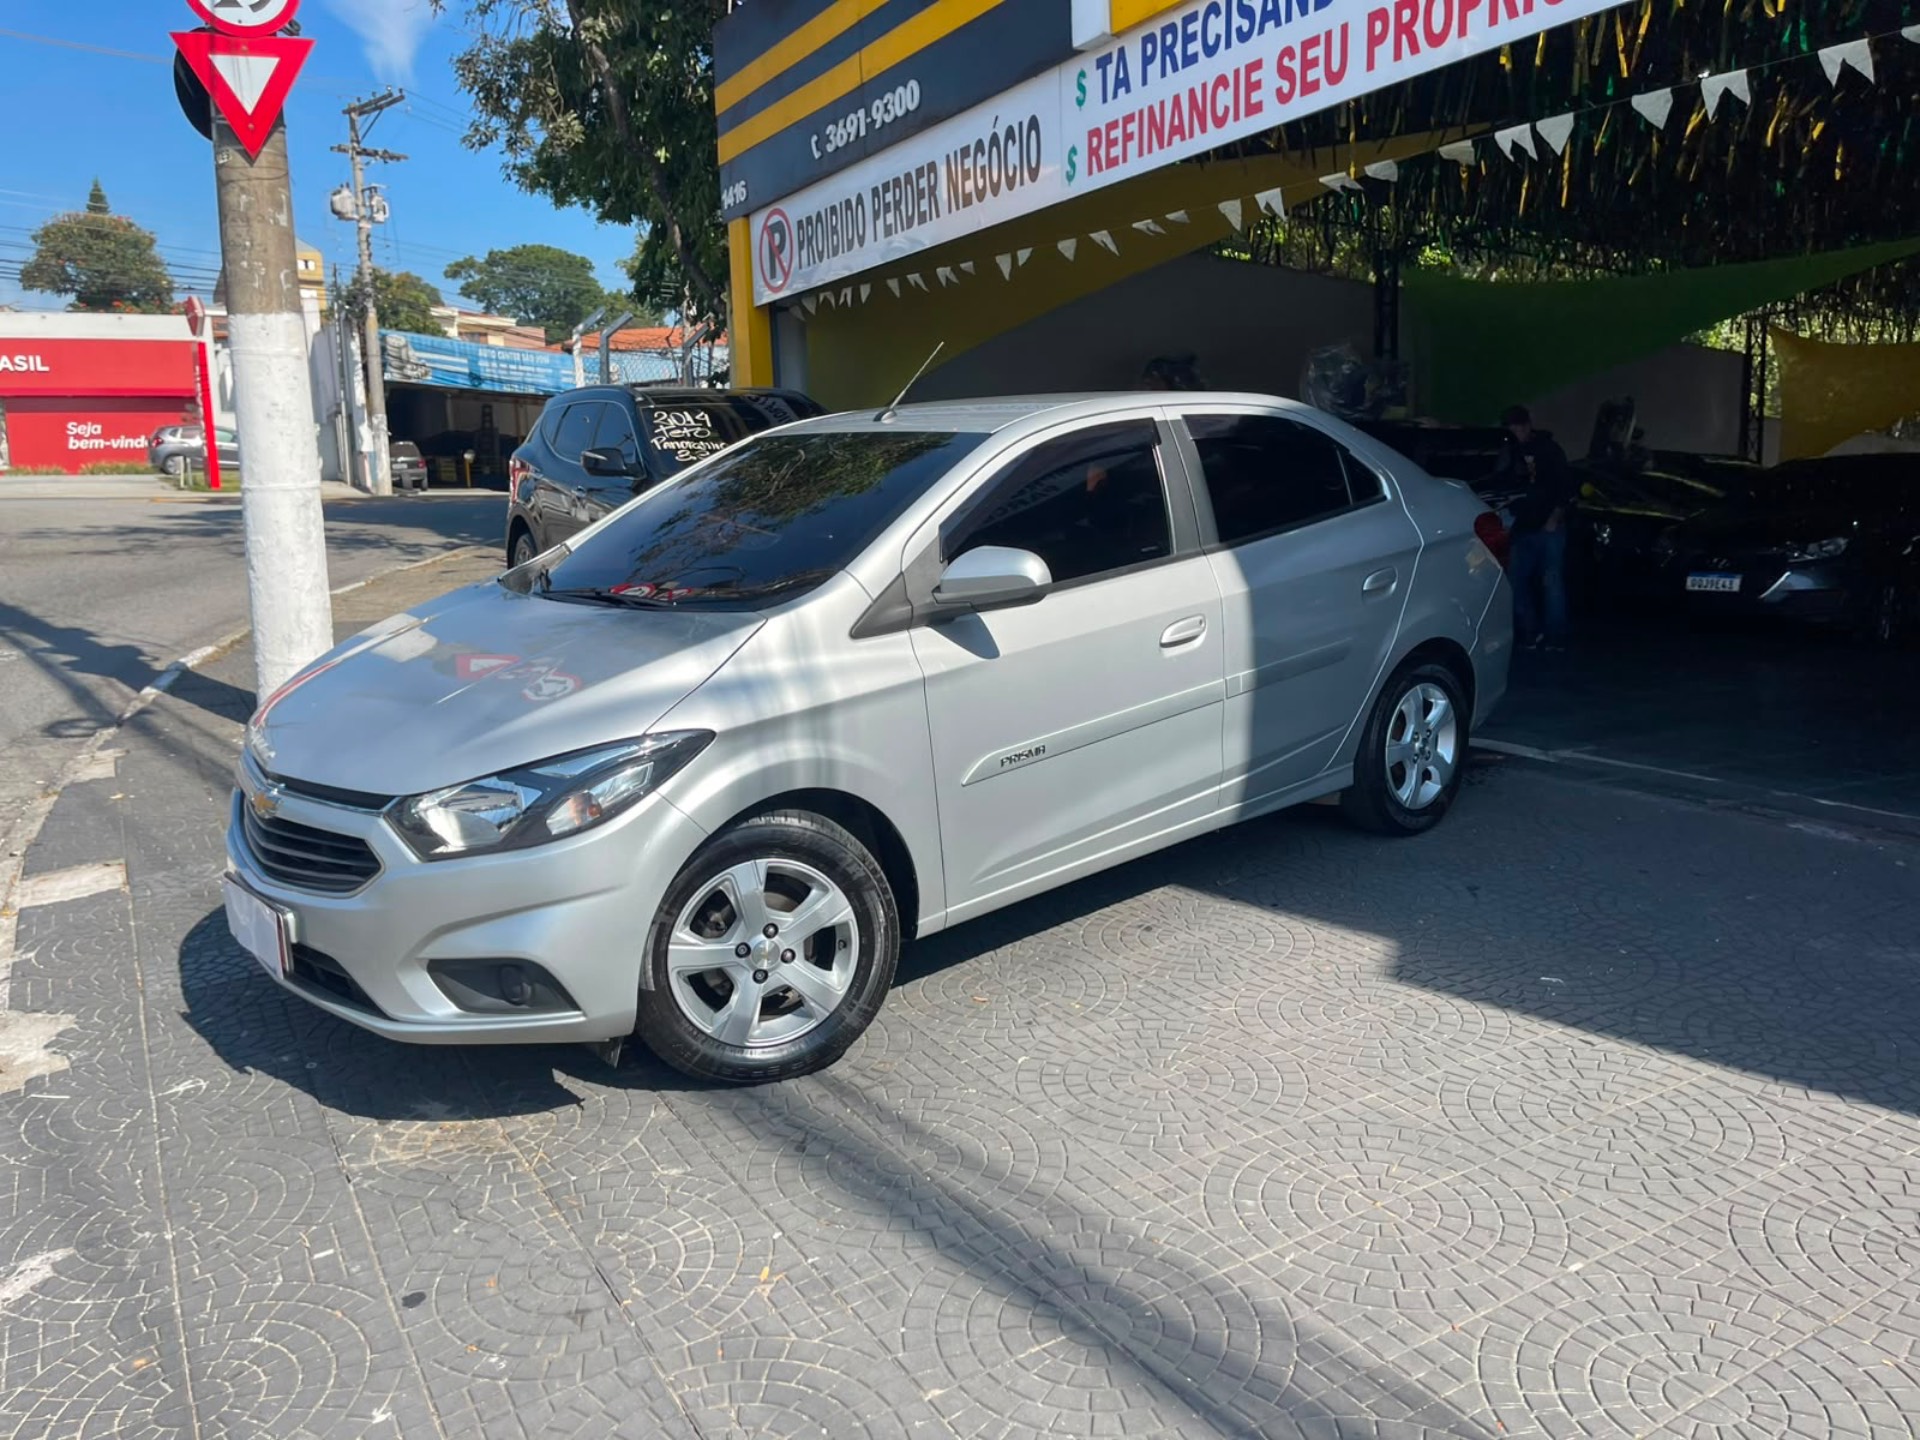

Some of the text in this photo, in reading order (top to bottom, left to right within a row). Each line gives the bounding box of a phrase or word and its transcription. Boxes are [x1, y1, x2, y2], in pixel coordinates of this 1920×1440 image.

[1087, 57, 1264, 177] REFINANCIE
[1275, 22, 1349, 105] SEU
[1365, 0, 1564, 72] PROP
[1096, 46, 1132, 104] TA
[1141, 0, 1334, 87] PRECISA
[825, 79, 920, 153] 3691-9300
[797, 114, 1041, 270] PROIBIDO PERDER NEGÓCIO
[0, 355, 50, 372] ASIL
[66, 421, 102, 437] Seja
[1000, 744, 1046, 768] PRISMA
